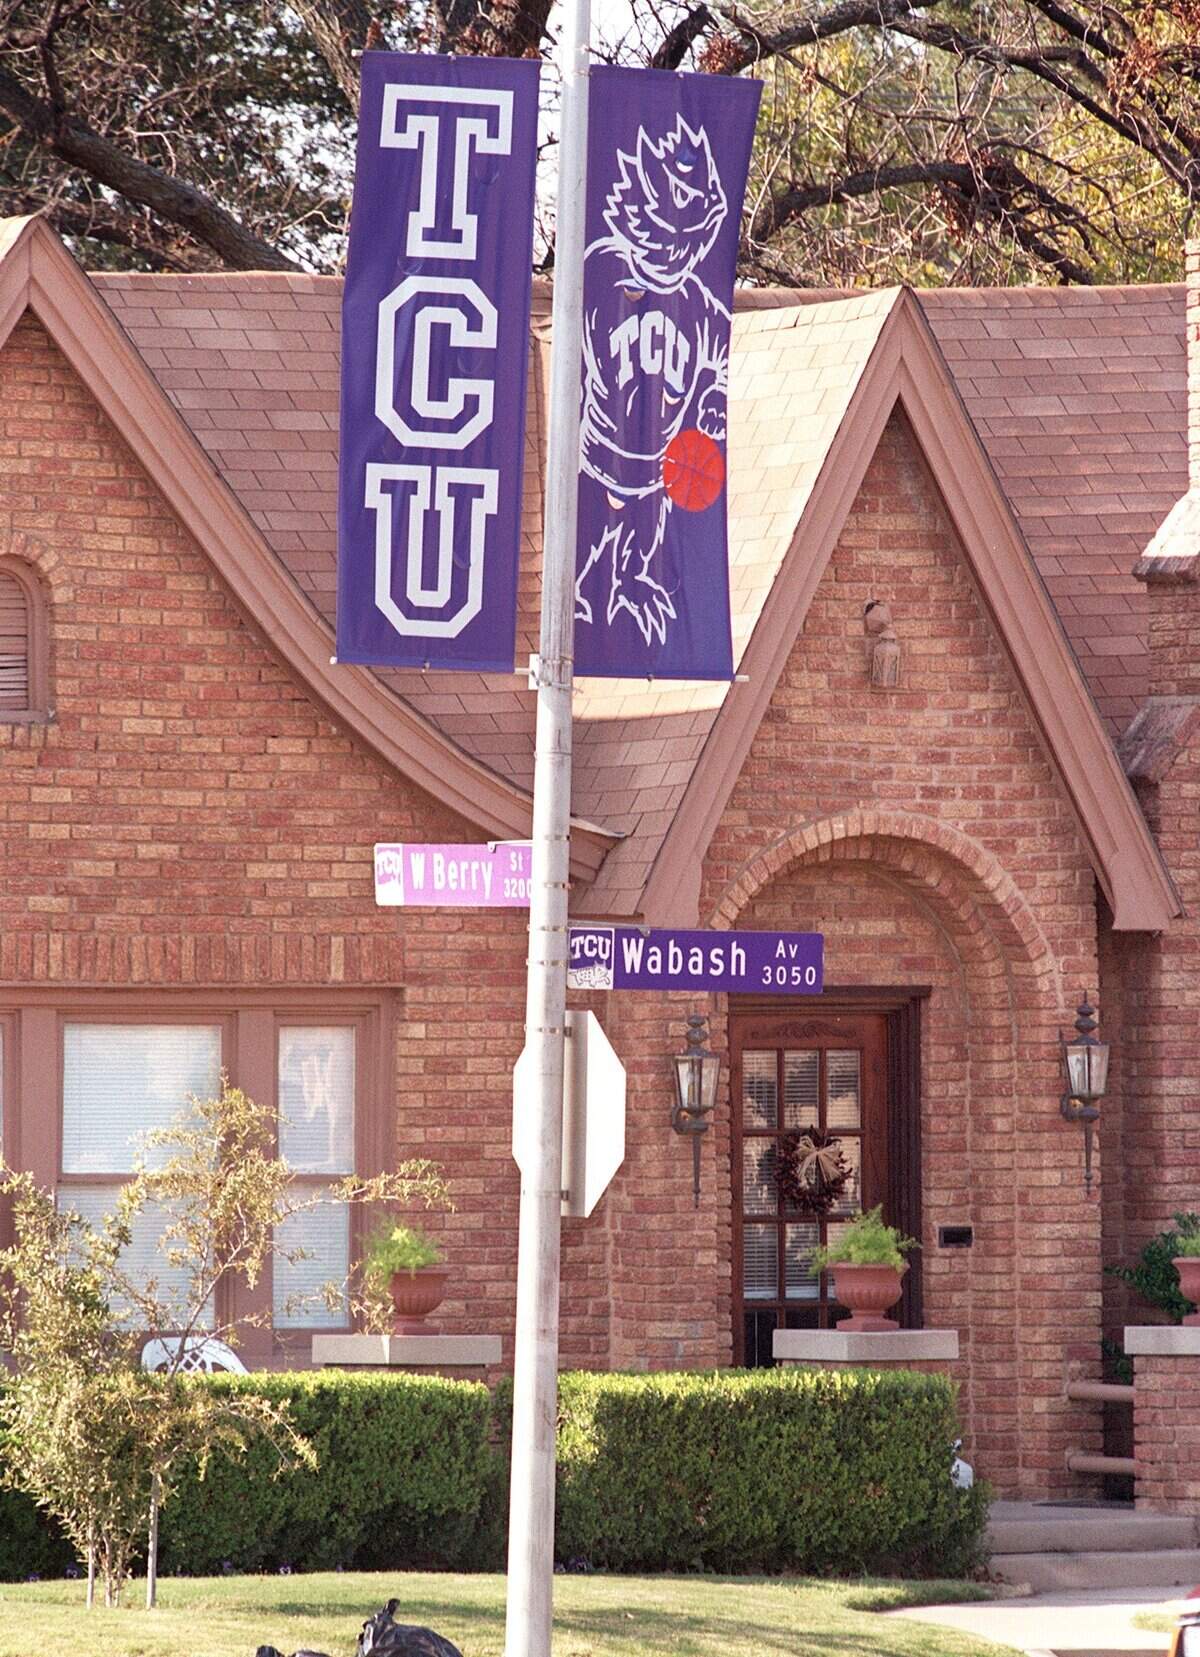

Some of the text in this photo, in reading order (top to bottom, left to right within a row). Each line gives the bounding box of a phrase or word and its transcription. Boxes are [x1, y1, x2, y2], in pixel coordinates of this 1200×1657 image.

[365, 83, 515, 639] TCU
[609, 310, 690, 393] TCU
[410, 852, 493, 900] W Berry
[509, 851, 524, 872] St
[571, 935, 611, 960] TCU
[622, 937, 746, 976] Wabash
[775, 939, 799, 959] Av
[761, 965, 816, 986] 3050
